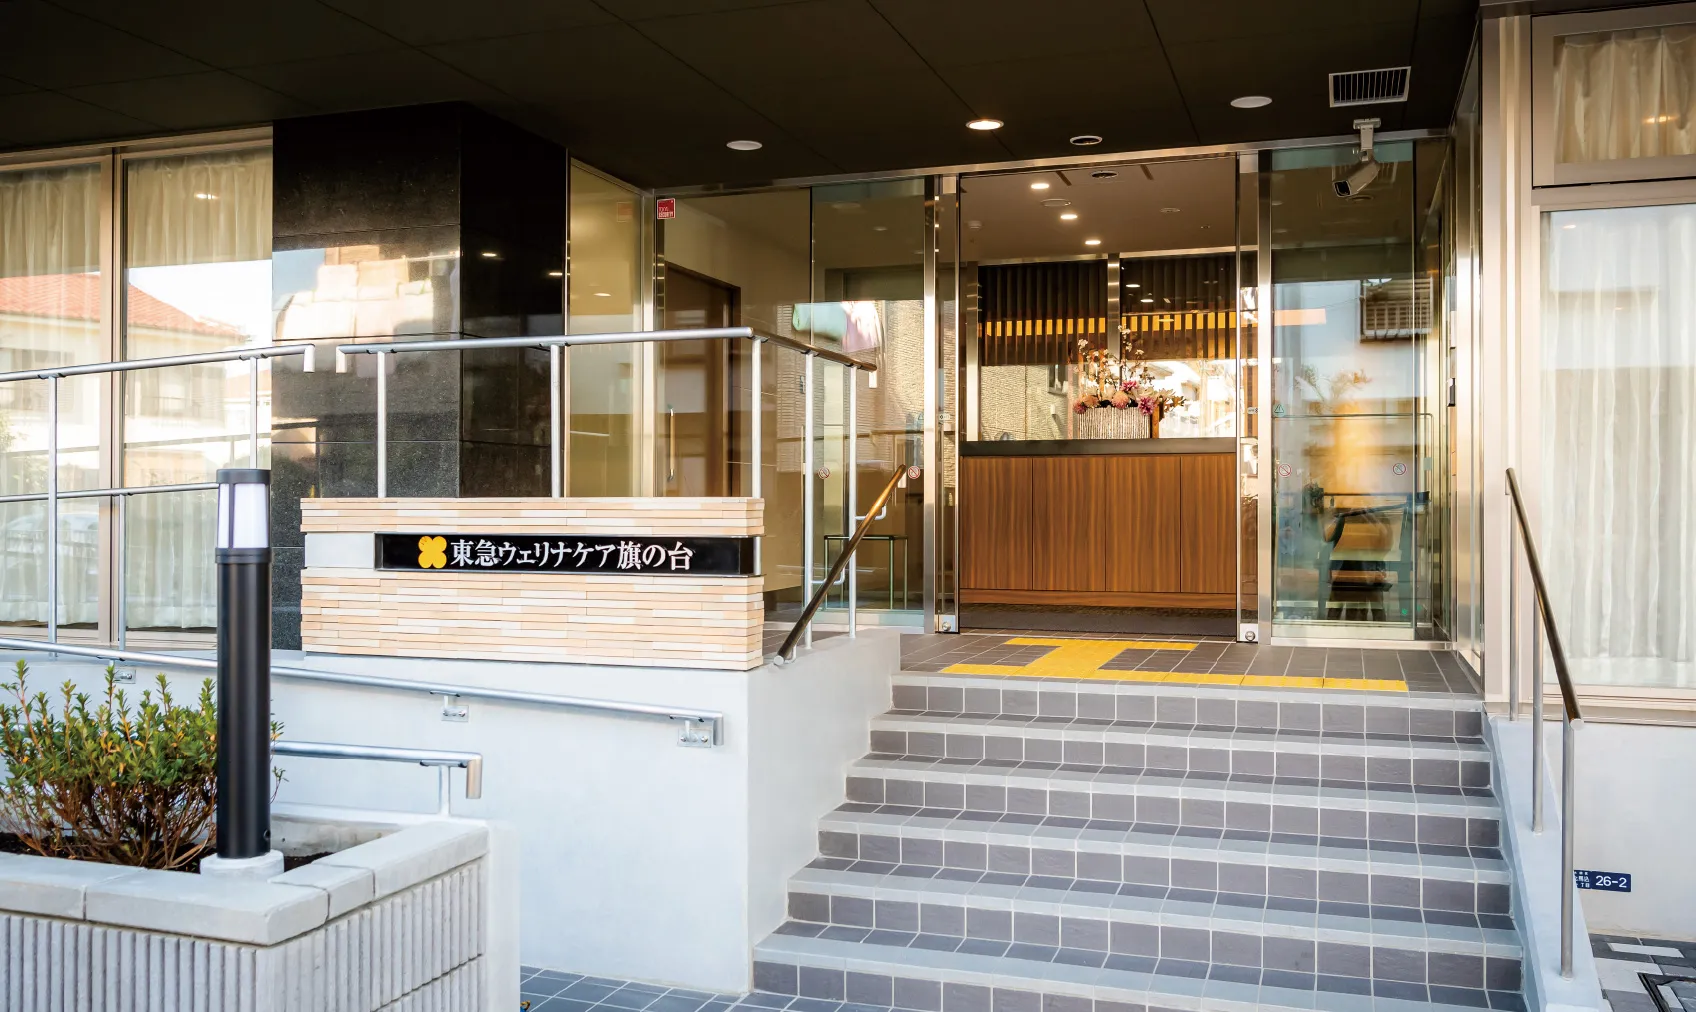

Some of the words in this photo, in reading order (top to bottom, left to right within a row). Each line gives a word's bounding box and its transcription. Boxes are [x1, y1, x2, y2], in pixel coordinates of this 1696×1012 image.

[450, 538, 694, 571] 東急ウェリナケア旗の台
[1595, 875, 1627, 888] 26-2
